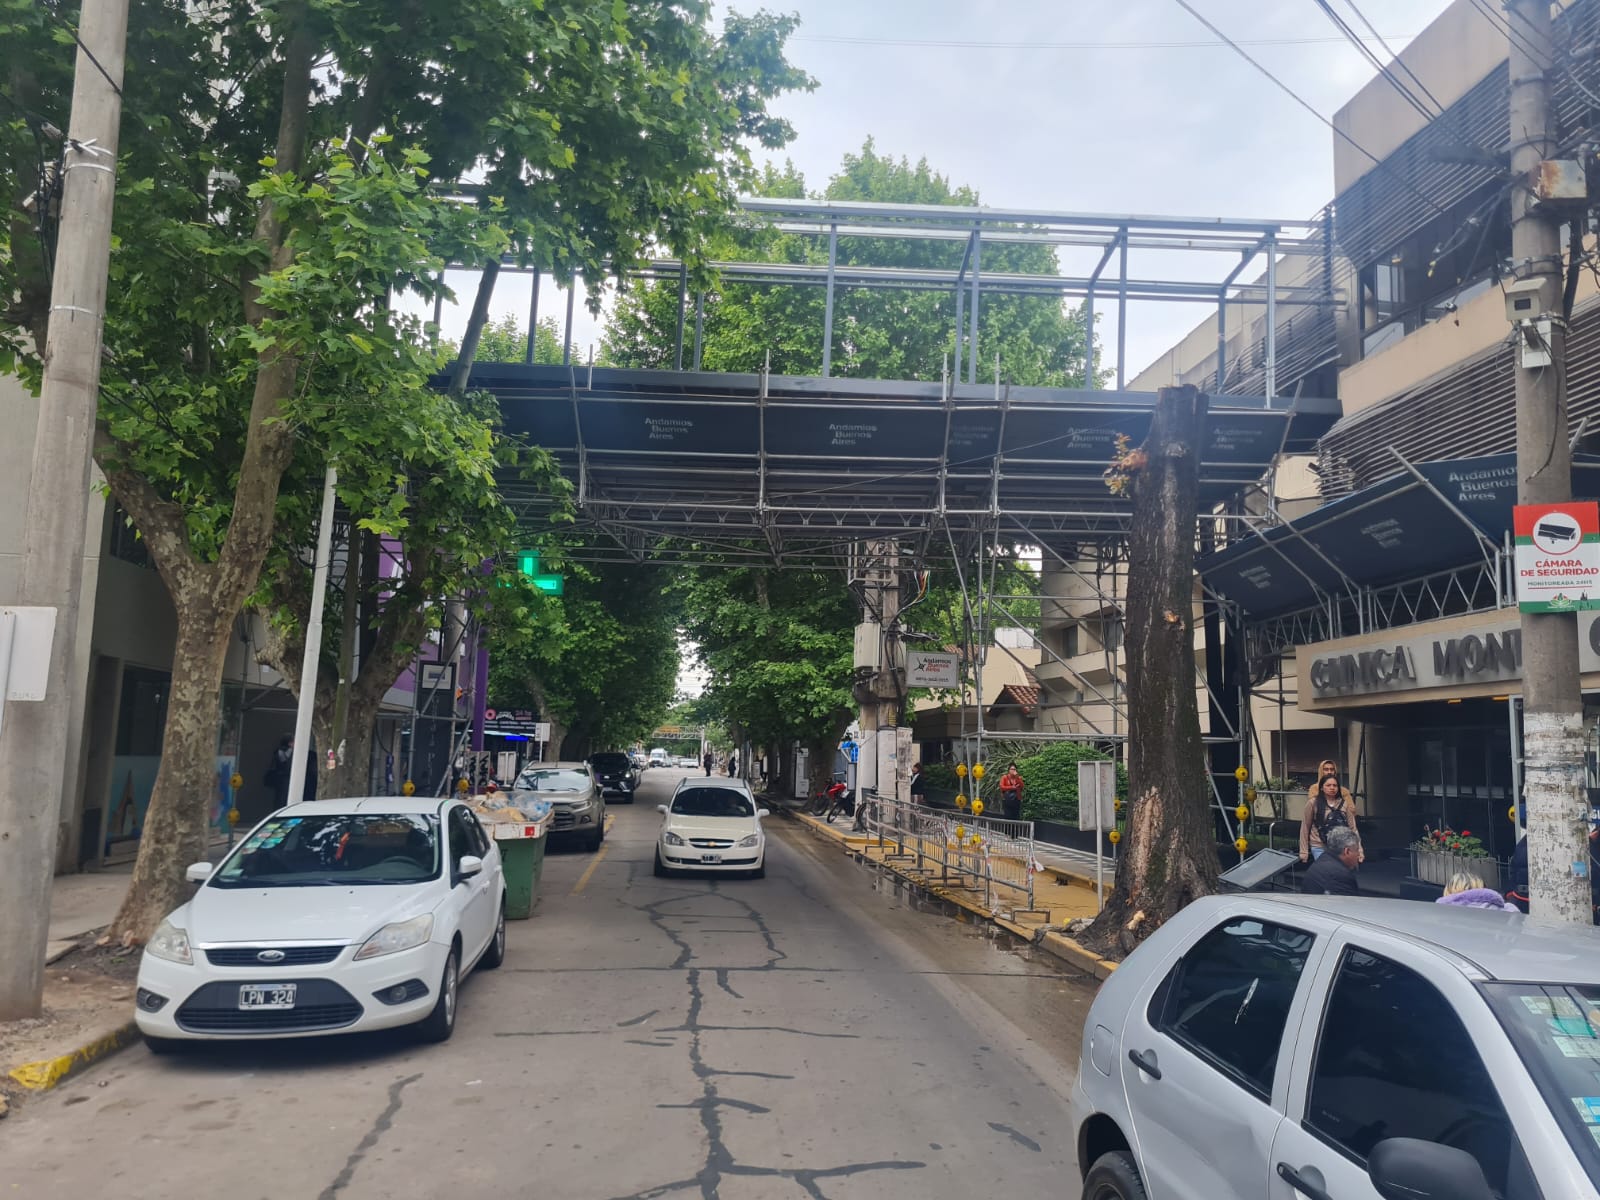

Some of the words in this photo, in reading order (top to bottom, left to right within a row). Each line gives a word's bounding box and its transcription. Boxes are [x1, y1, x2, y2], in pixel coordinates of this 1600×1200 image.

[829, 423, 878, 431] Andamios
[1449, 466, 1517, 482] Andamio
[1459, 492, 1496, 501] Aires
[1535, 559, 1583, 568] CÁMARA
[1520, 569, 1535, 577] DE
[1537, 567, 1599, 577] SEGURIDAD
[241, 990, 265, 1005] LPN
[271, 989, 294, 1004] 324
